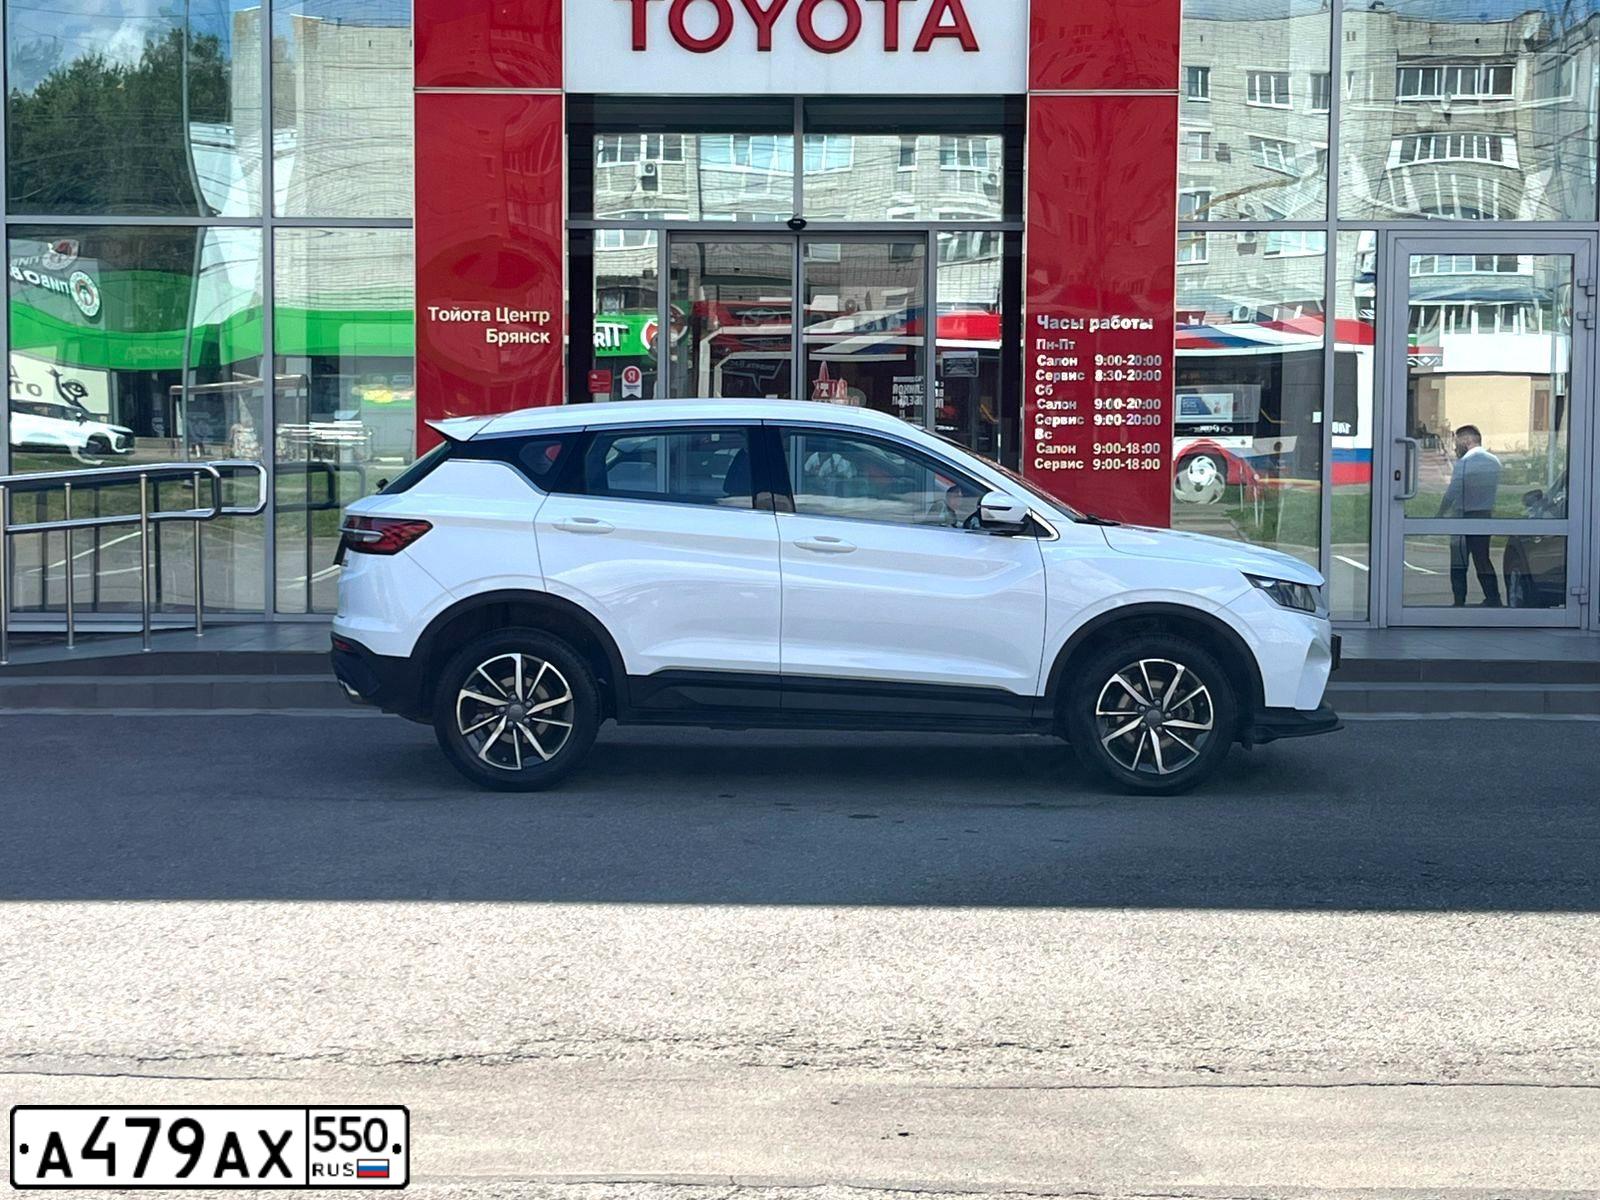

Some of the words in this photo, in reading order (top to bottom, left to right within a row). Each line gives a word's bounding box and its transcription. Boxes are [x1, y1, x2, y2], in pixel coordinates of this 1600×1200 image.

[614, 0, 980, 54] TOYOTA
[427, 306, 491, 322] Тойота
[495, 306, 551, 326] Центр
[1036, 314, 1085, 330] Часы
[1088, 314, 1154, 333] работы
[485, 328, 551, 347] Брянск
[1035, 338, 1076, 351] Пн-Пт
[1036, 354, 1079, 367] Салон
[1094, 354, 1162, 367] 9:00-20:00
[1035, 369, 1086, 383] Сервис
[1094, 369, 1162, 382] 8:30-20:00
[1034, 383, 1054, 396] Сб
[1036, 398, 1077, 410] Салон
[1093, 398, 1162, 410] 9:00-20:00
[1034, 413, 1085, 428] Сервис
[1093, 413, 1161, 426] 9:00-20:00
[1034, 428, 1053, 440] Вс
[1035, 442, 1077, 454] Салон
[1092, 442, 1161, 455] 9:00-18:00
[1034, 458, 1085, 471] Сервис
[1092, 458, 1161, 471] 9:00-18:00
